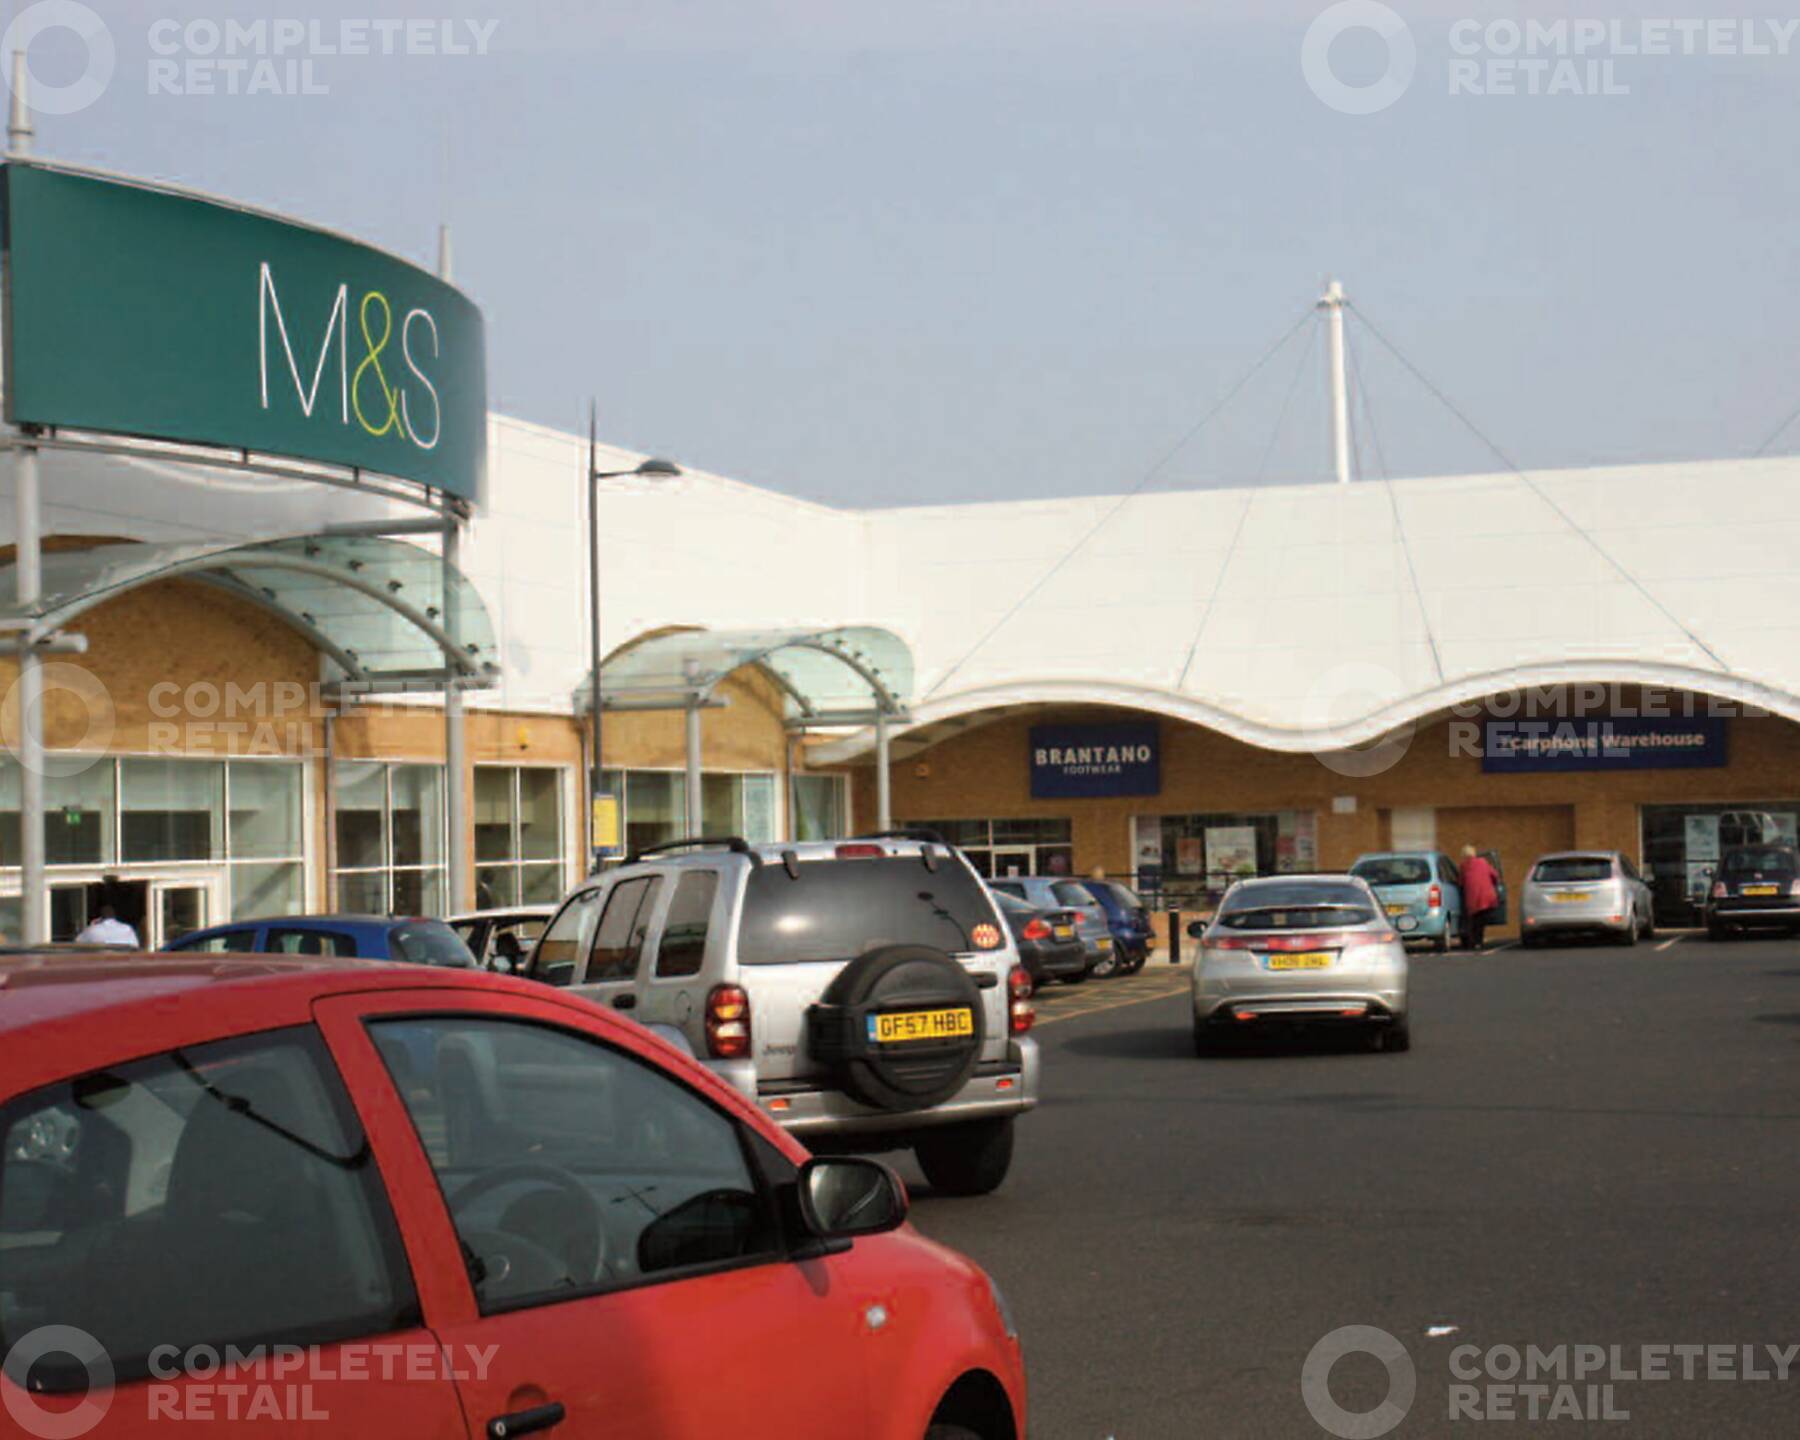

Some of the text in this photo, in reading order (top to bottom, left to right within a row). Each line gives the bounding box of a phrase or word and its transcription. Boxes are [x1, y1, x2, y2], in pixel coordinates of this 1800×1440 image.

[259, 262, 440, 449] M&S
[1511, 734, 1597, 752] Carphone
[1602, 731, 1705, 748] Warehouse
[1035, 745, 1151, 766] BRANTANO
[933, 1011, 968, 1033] HBC
